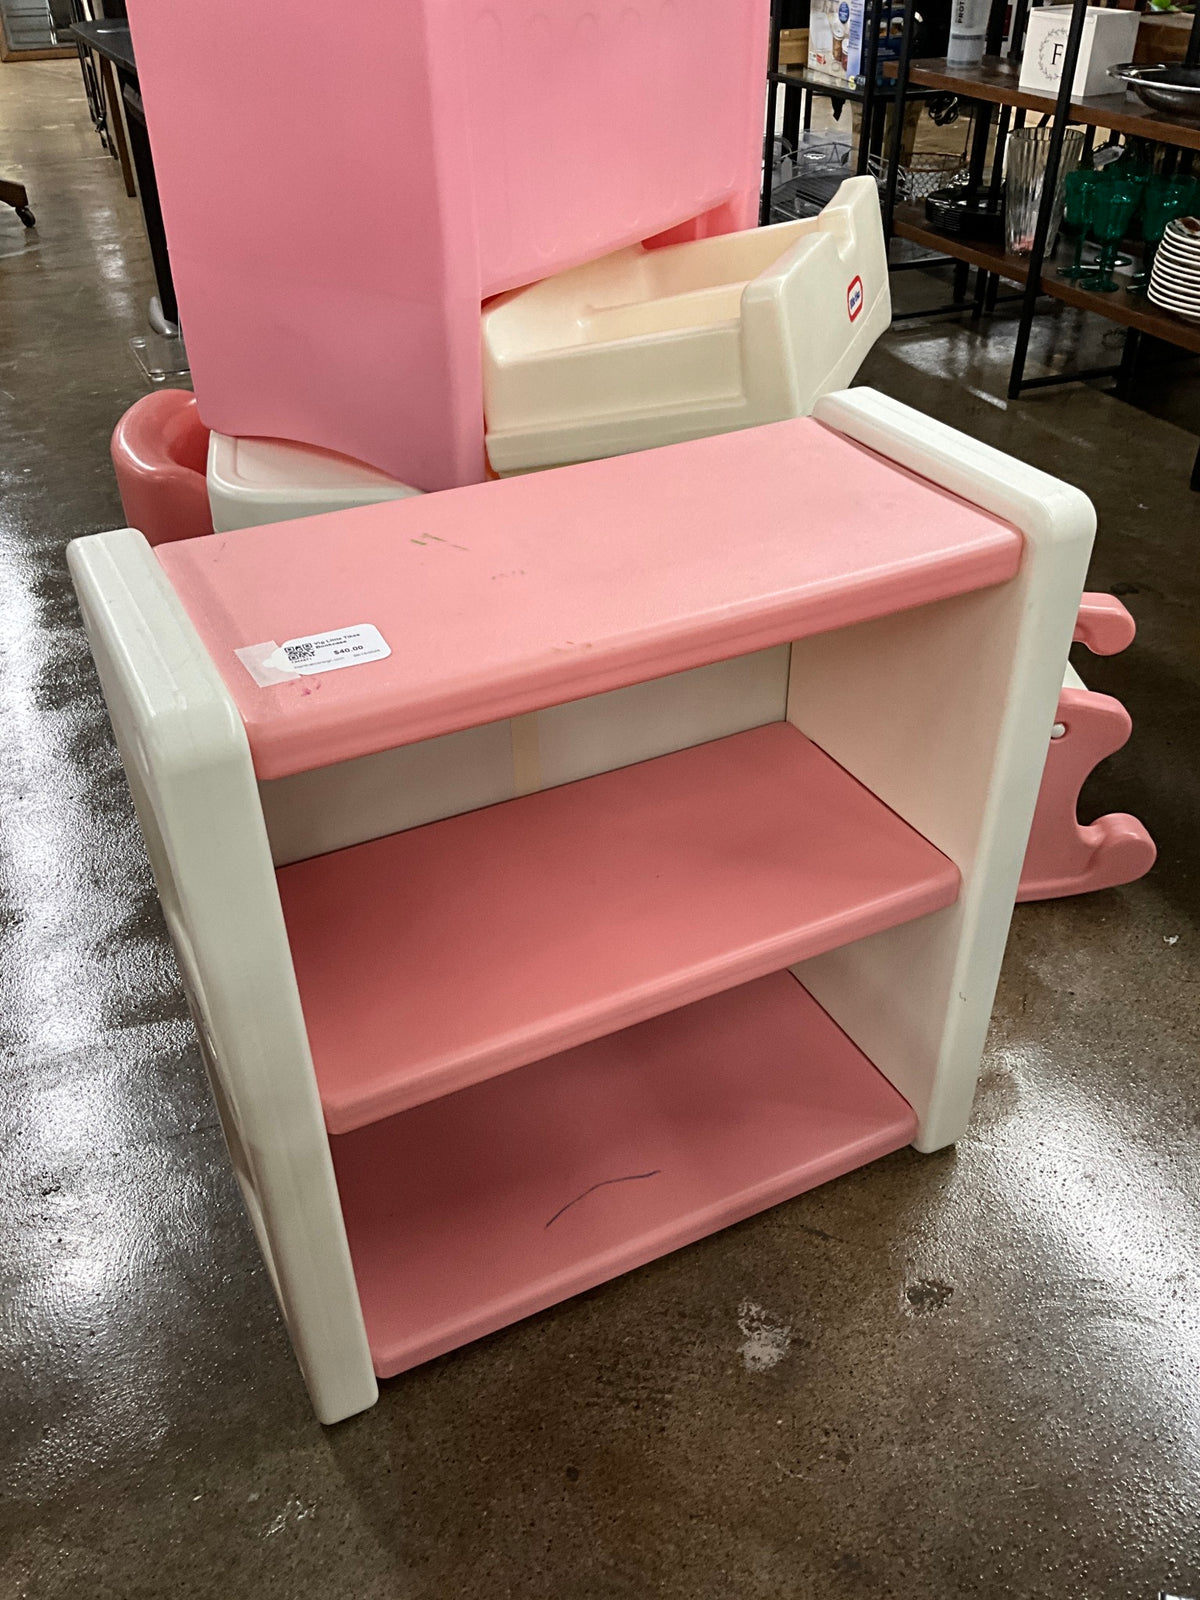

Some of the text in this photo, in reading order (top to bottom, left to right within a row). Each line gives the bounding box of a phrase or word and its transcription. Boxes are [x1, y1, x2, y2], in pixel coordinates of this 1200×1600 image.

[1051, 43, 1064, 65] F
[315, 640, 348, 649] Bookcase
[333, 645, 364, 655] $40.00
